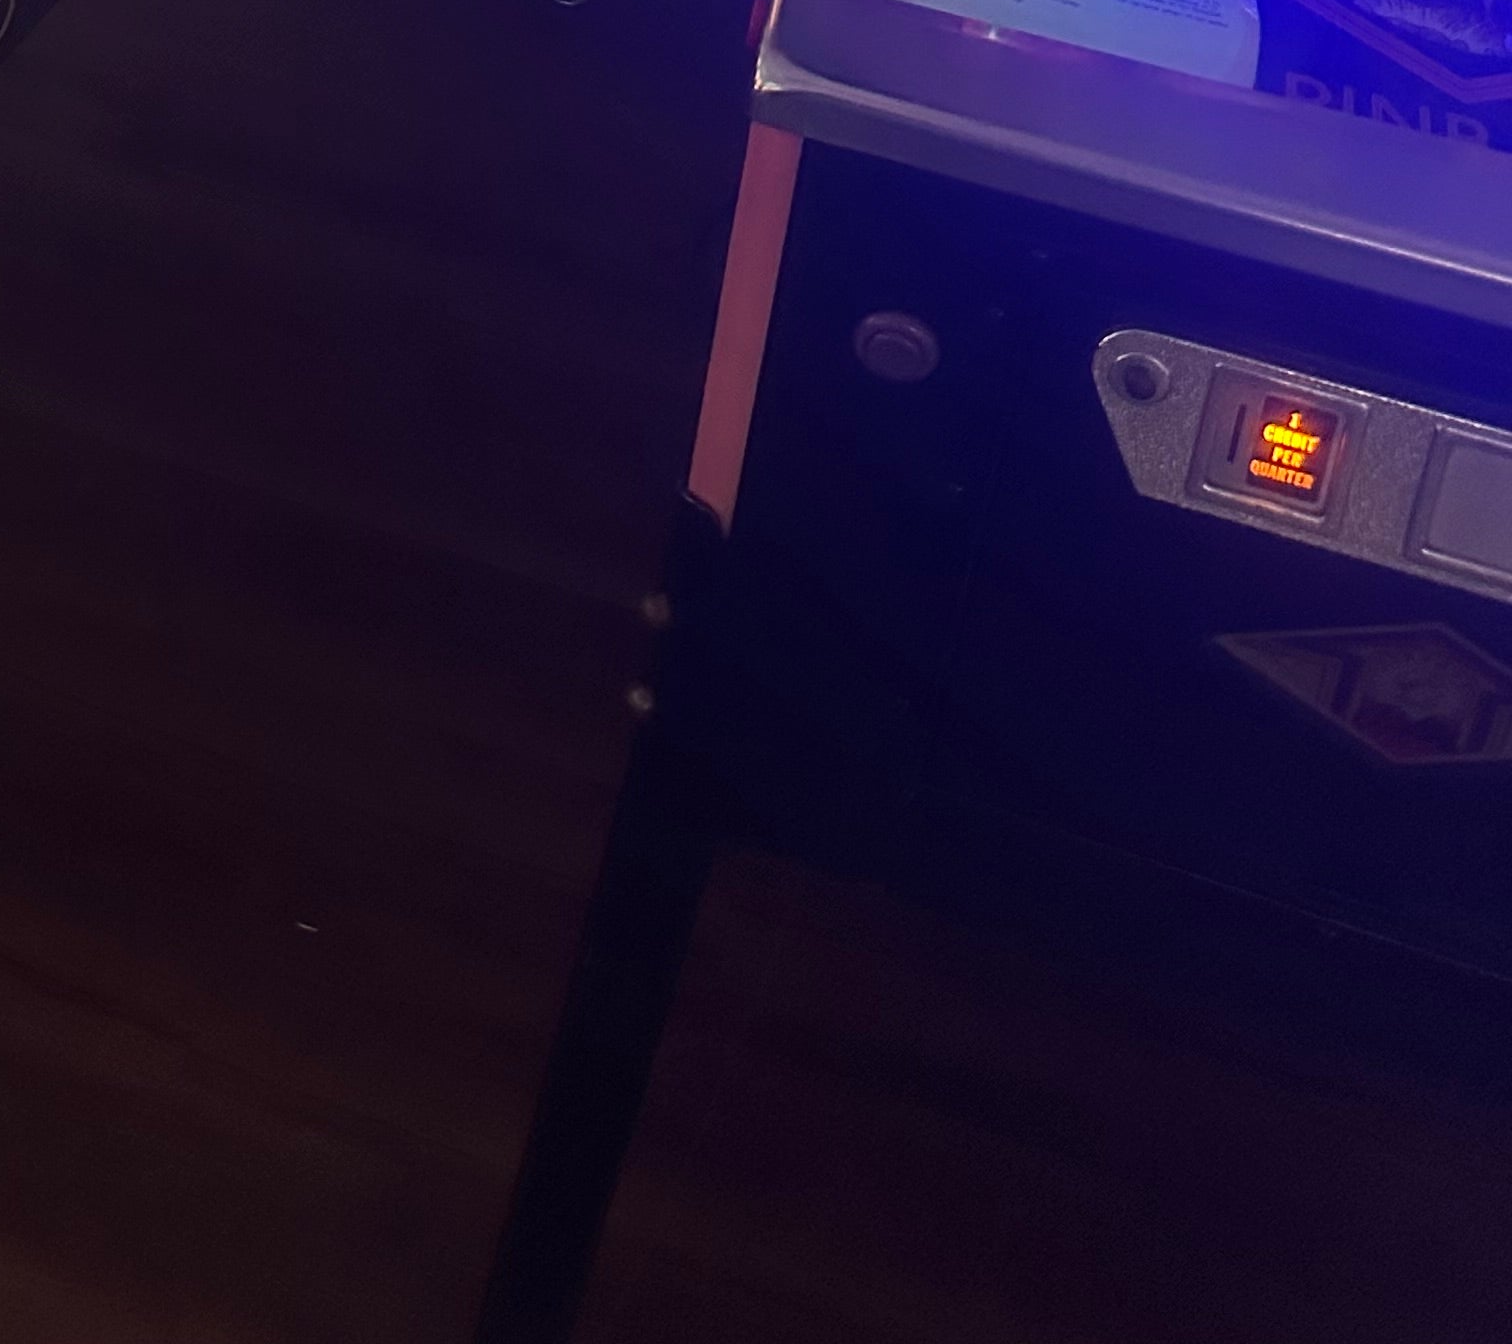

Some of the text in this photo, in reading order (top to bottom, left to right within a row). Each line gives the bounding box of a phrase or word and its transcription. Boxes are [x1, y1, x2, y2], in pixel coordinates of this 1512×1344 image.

[1263, 423, 1321, 454] CREDIT
[1272, 446, 1306, 468] PER
[1249, 459, 1316, 491] QUARTER
